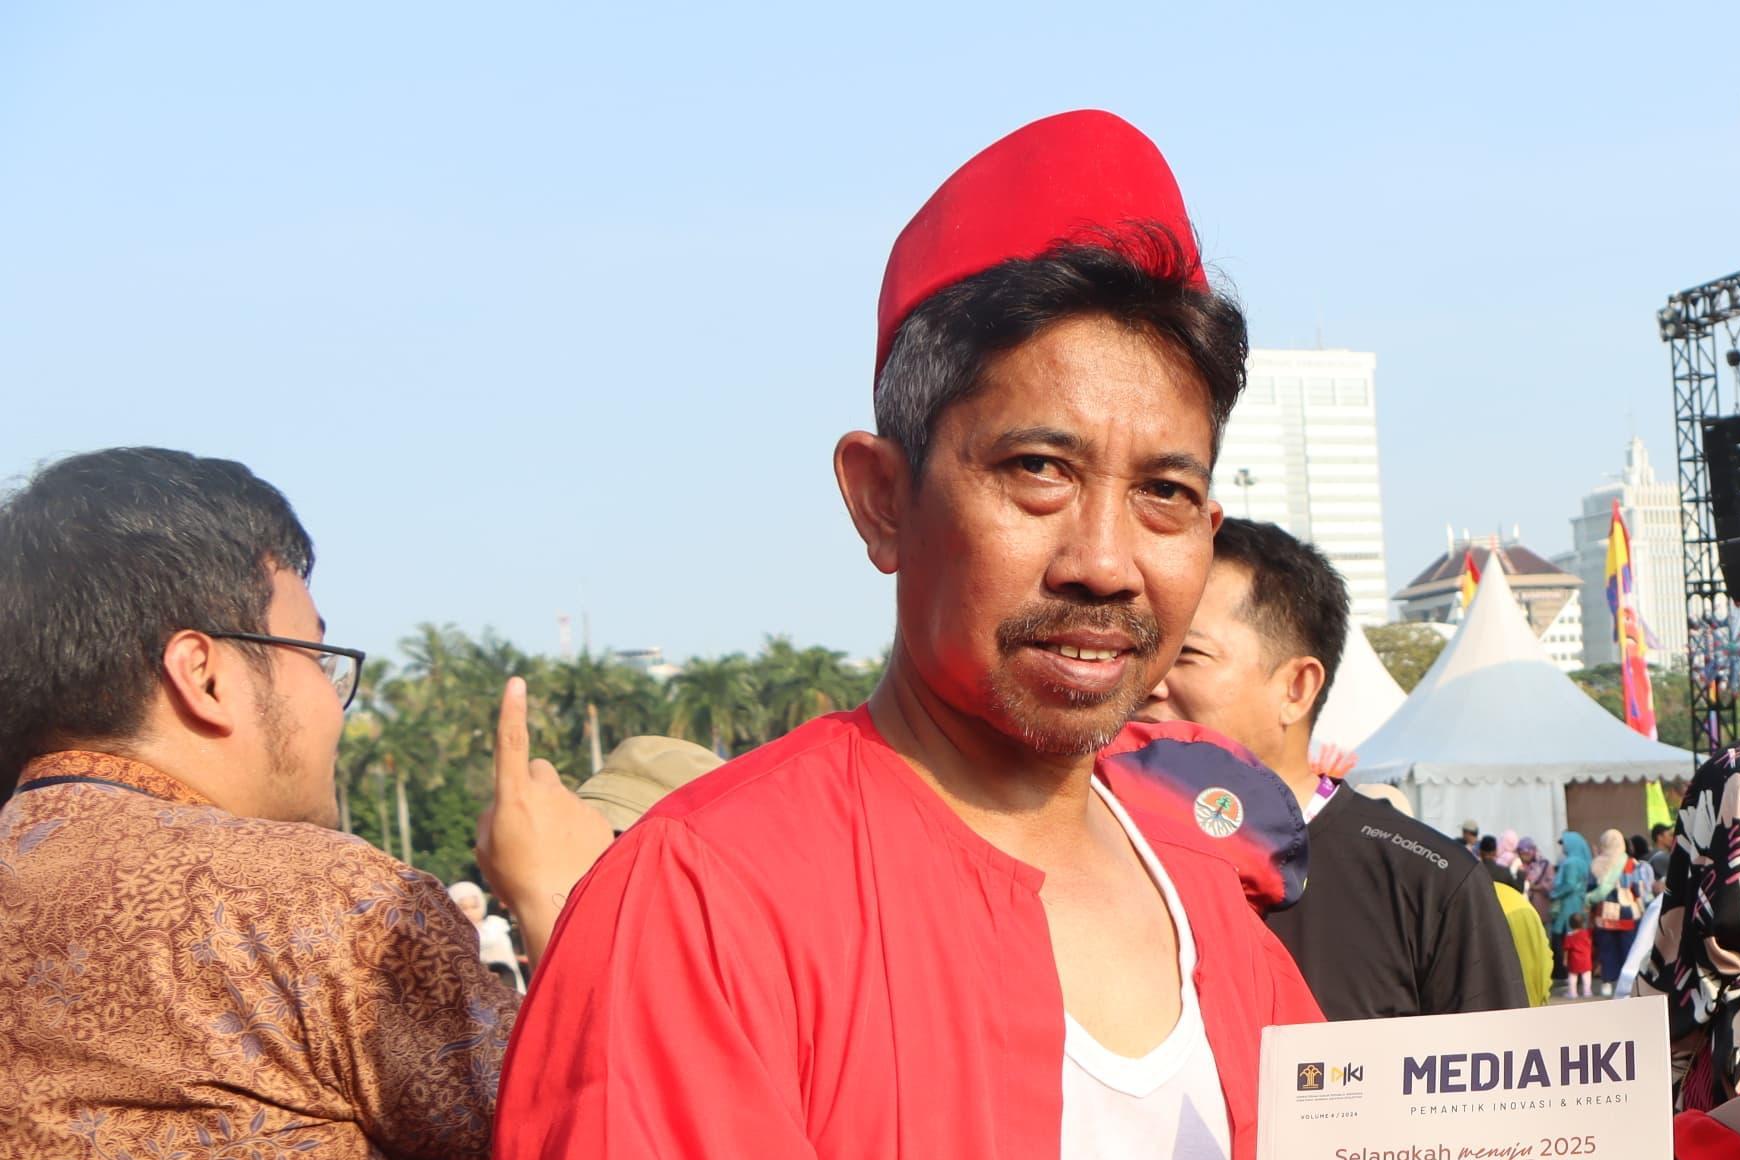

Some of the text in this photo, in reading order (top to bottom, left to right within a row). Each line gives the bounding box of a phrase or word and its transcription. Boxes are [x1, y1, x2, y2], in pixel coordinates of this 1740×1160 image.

[1361, 823, 1449, 869] new balance
[1403, 1040, 1635, 1095] MEDIA HKI
[1410, 1094, 1629, 1115] PEMANTIK INOVASI & KREASI
[1540, 1135, 1596, 1156] 2025
